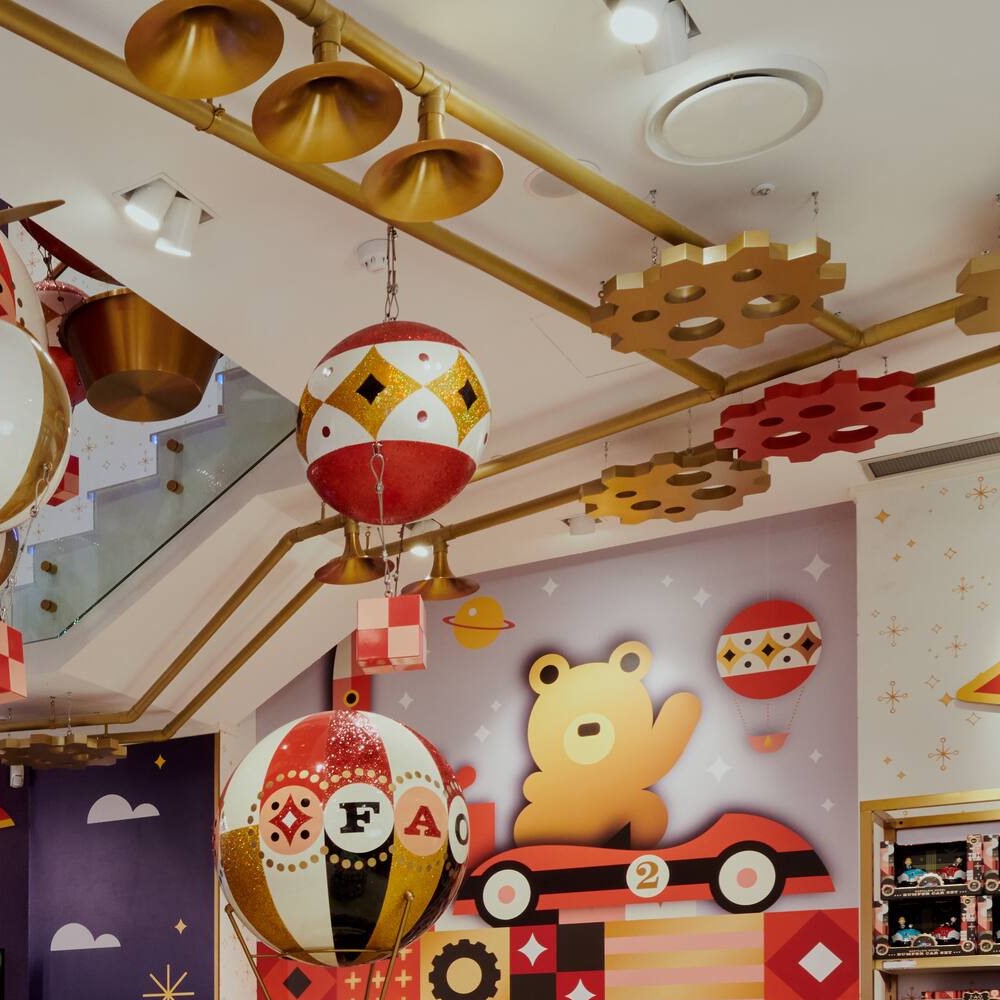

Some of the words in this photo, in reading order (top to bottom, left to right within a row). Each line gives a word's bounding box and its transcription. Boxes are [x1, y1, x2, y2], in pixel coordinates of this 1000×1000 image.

[339, 801, 380, 834] F
[404, 805, 442, 838] A
[636, 860, 660, 890] 2
